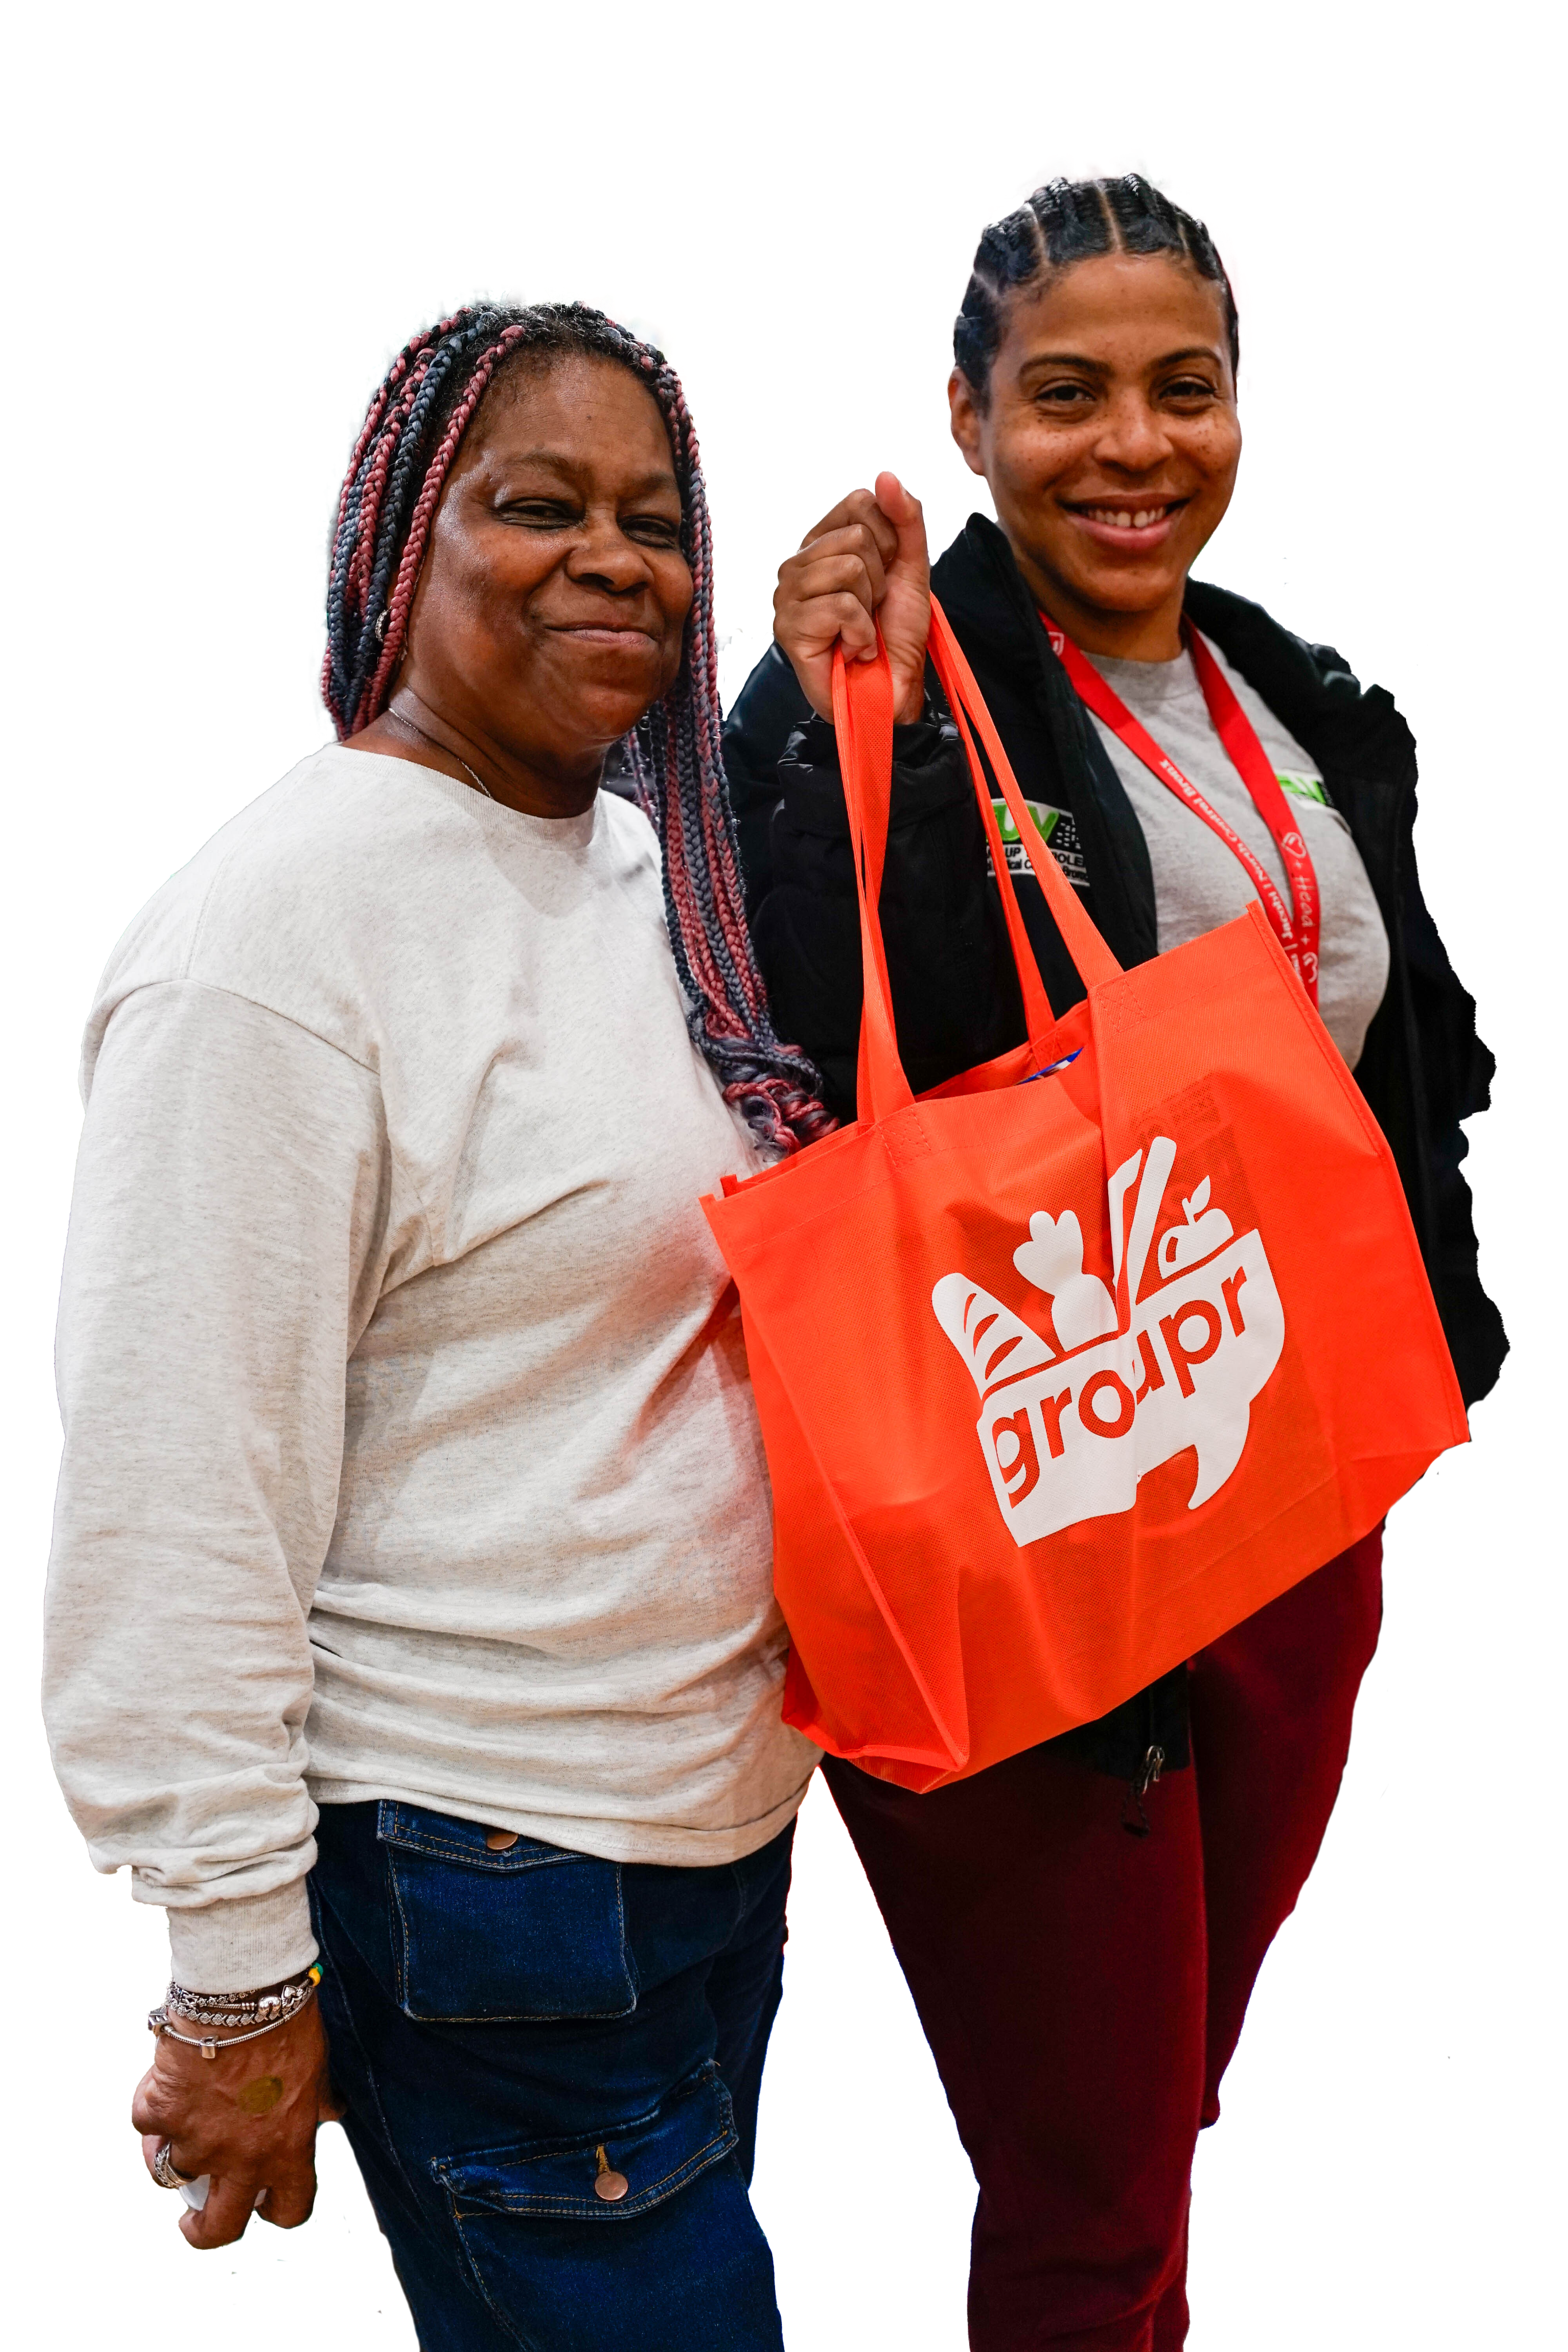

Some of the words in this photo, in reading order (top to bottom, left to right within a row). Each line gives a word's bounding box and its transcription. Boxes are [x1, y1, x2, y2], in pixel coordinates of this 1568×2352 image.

[1160, 759, 1196, 797] Bronx
[1194, 798, 1237, 841] Central
[1005, 847, 1021, 857] UP
[1238, 843, 1265, 881] North
